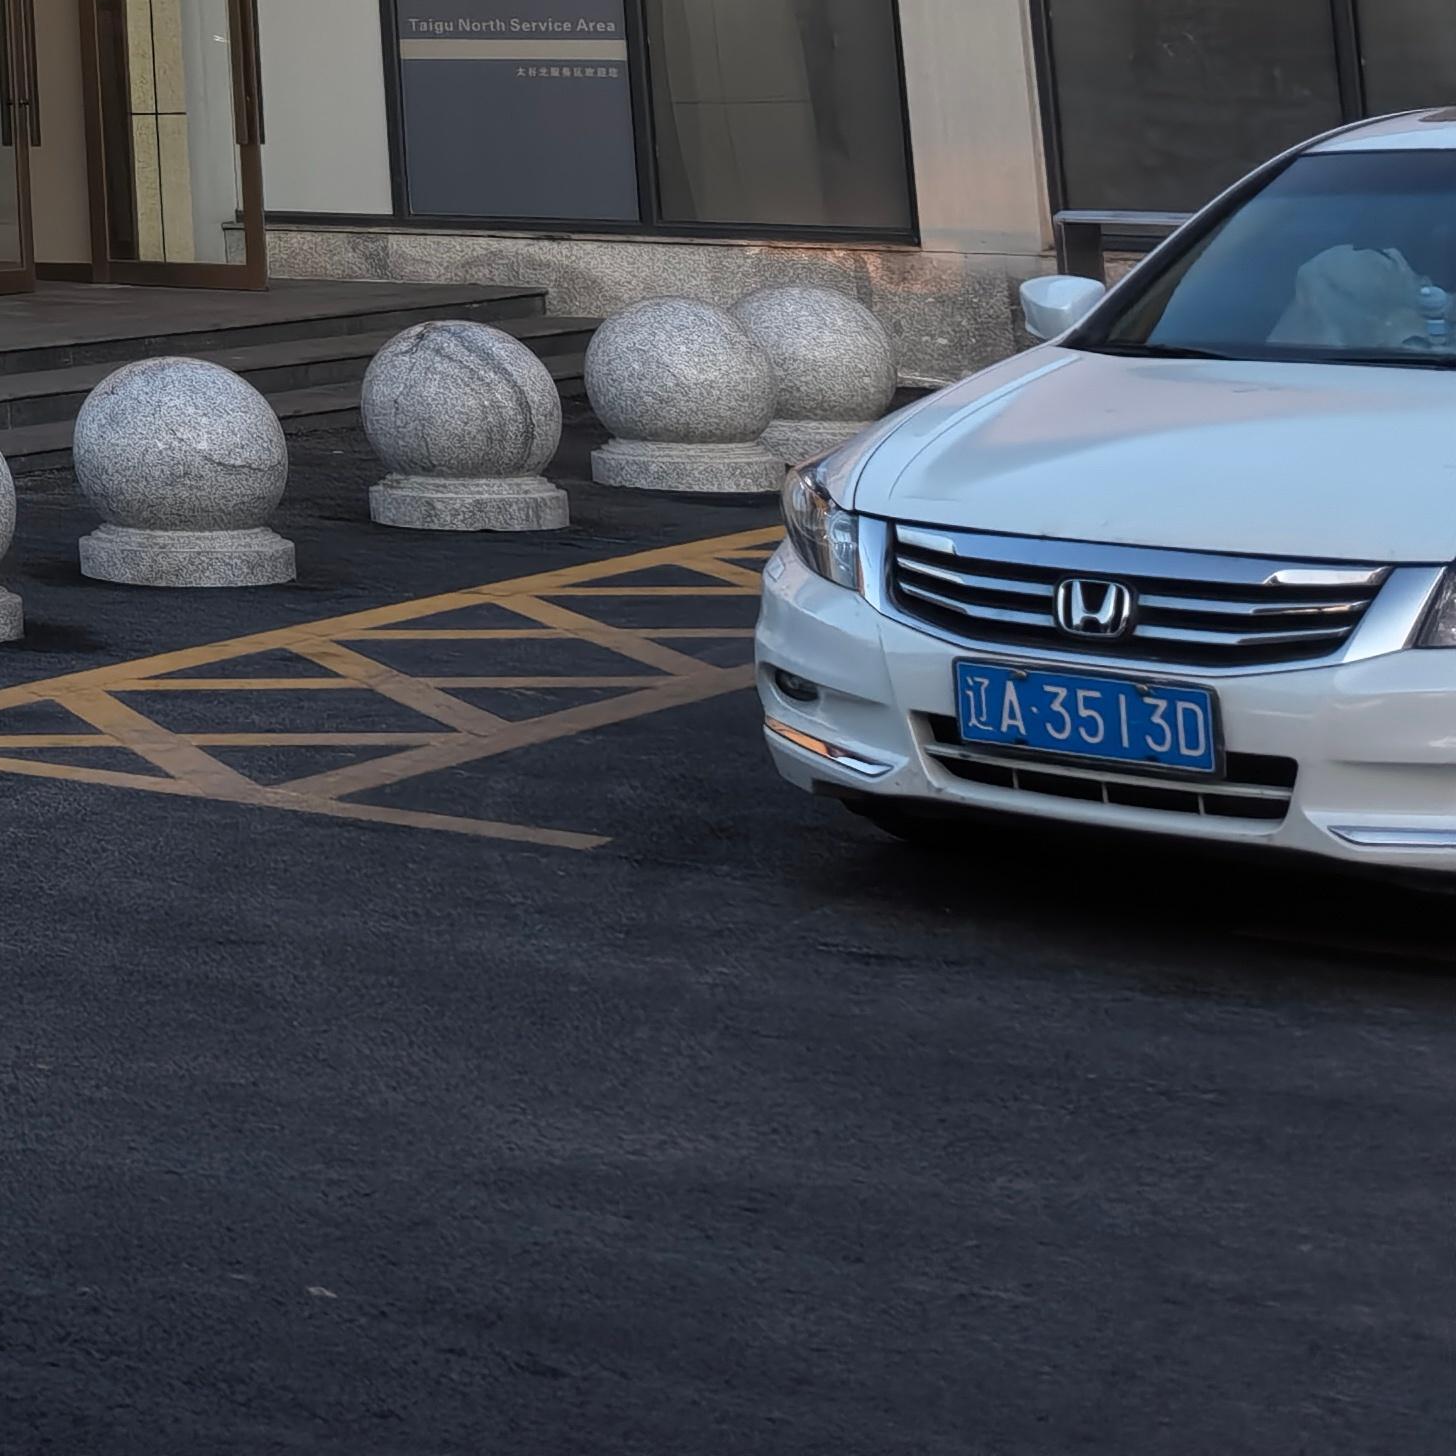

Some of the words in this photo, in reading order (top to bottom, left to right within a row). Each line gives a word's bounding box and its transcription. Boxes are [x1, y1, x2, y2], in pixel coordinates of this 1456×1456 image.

[408, 18, 454, 35] Taigu
[458, 17, 506, 33] North
[510, 17, 572, 33] Service
[576, 18, 616, 33] Area
